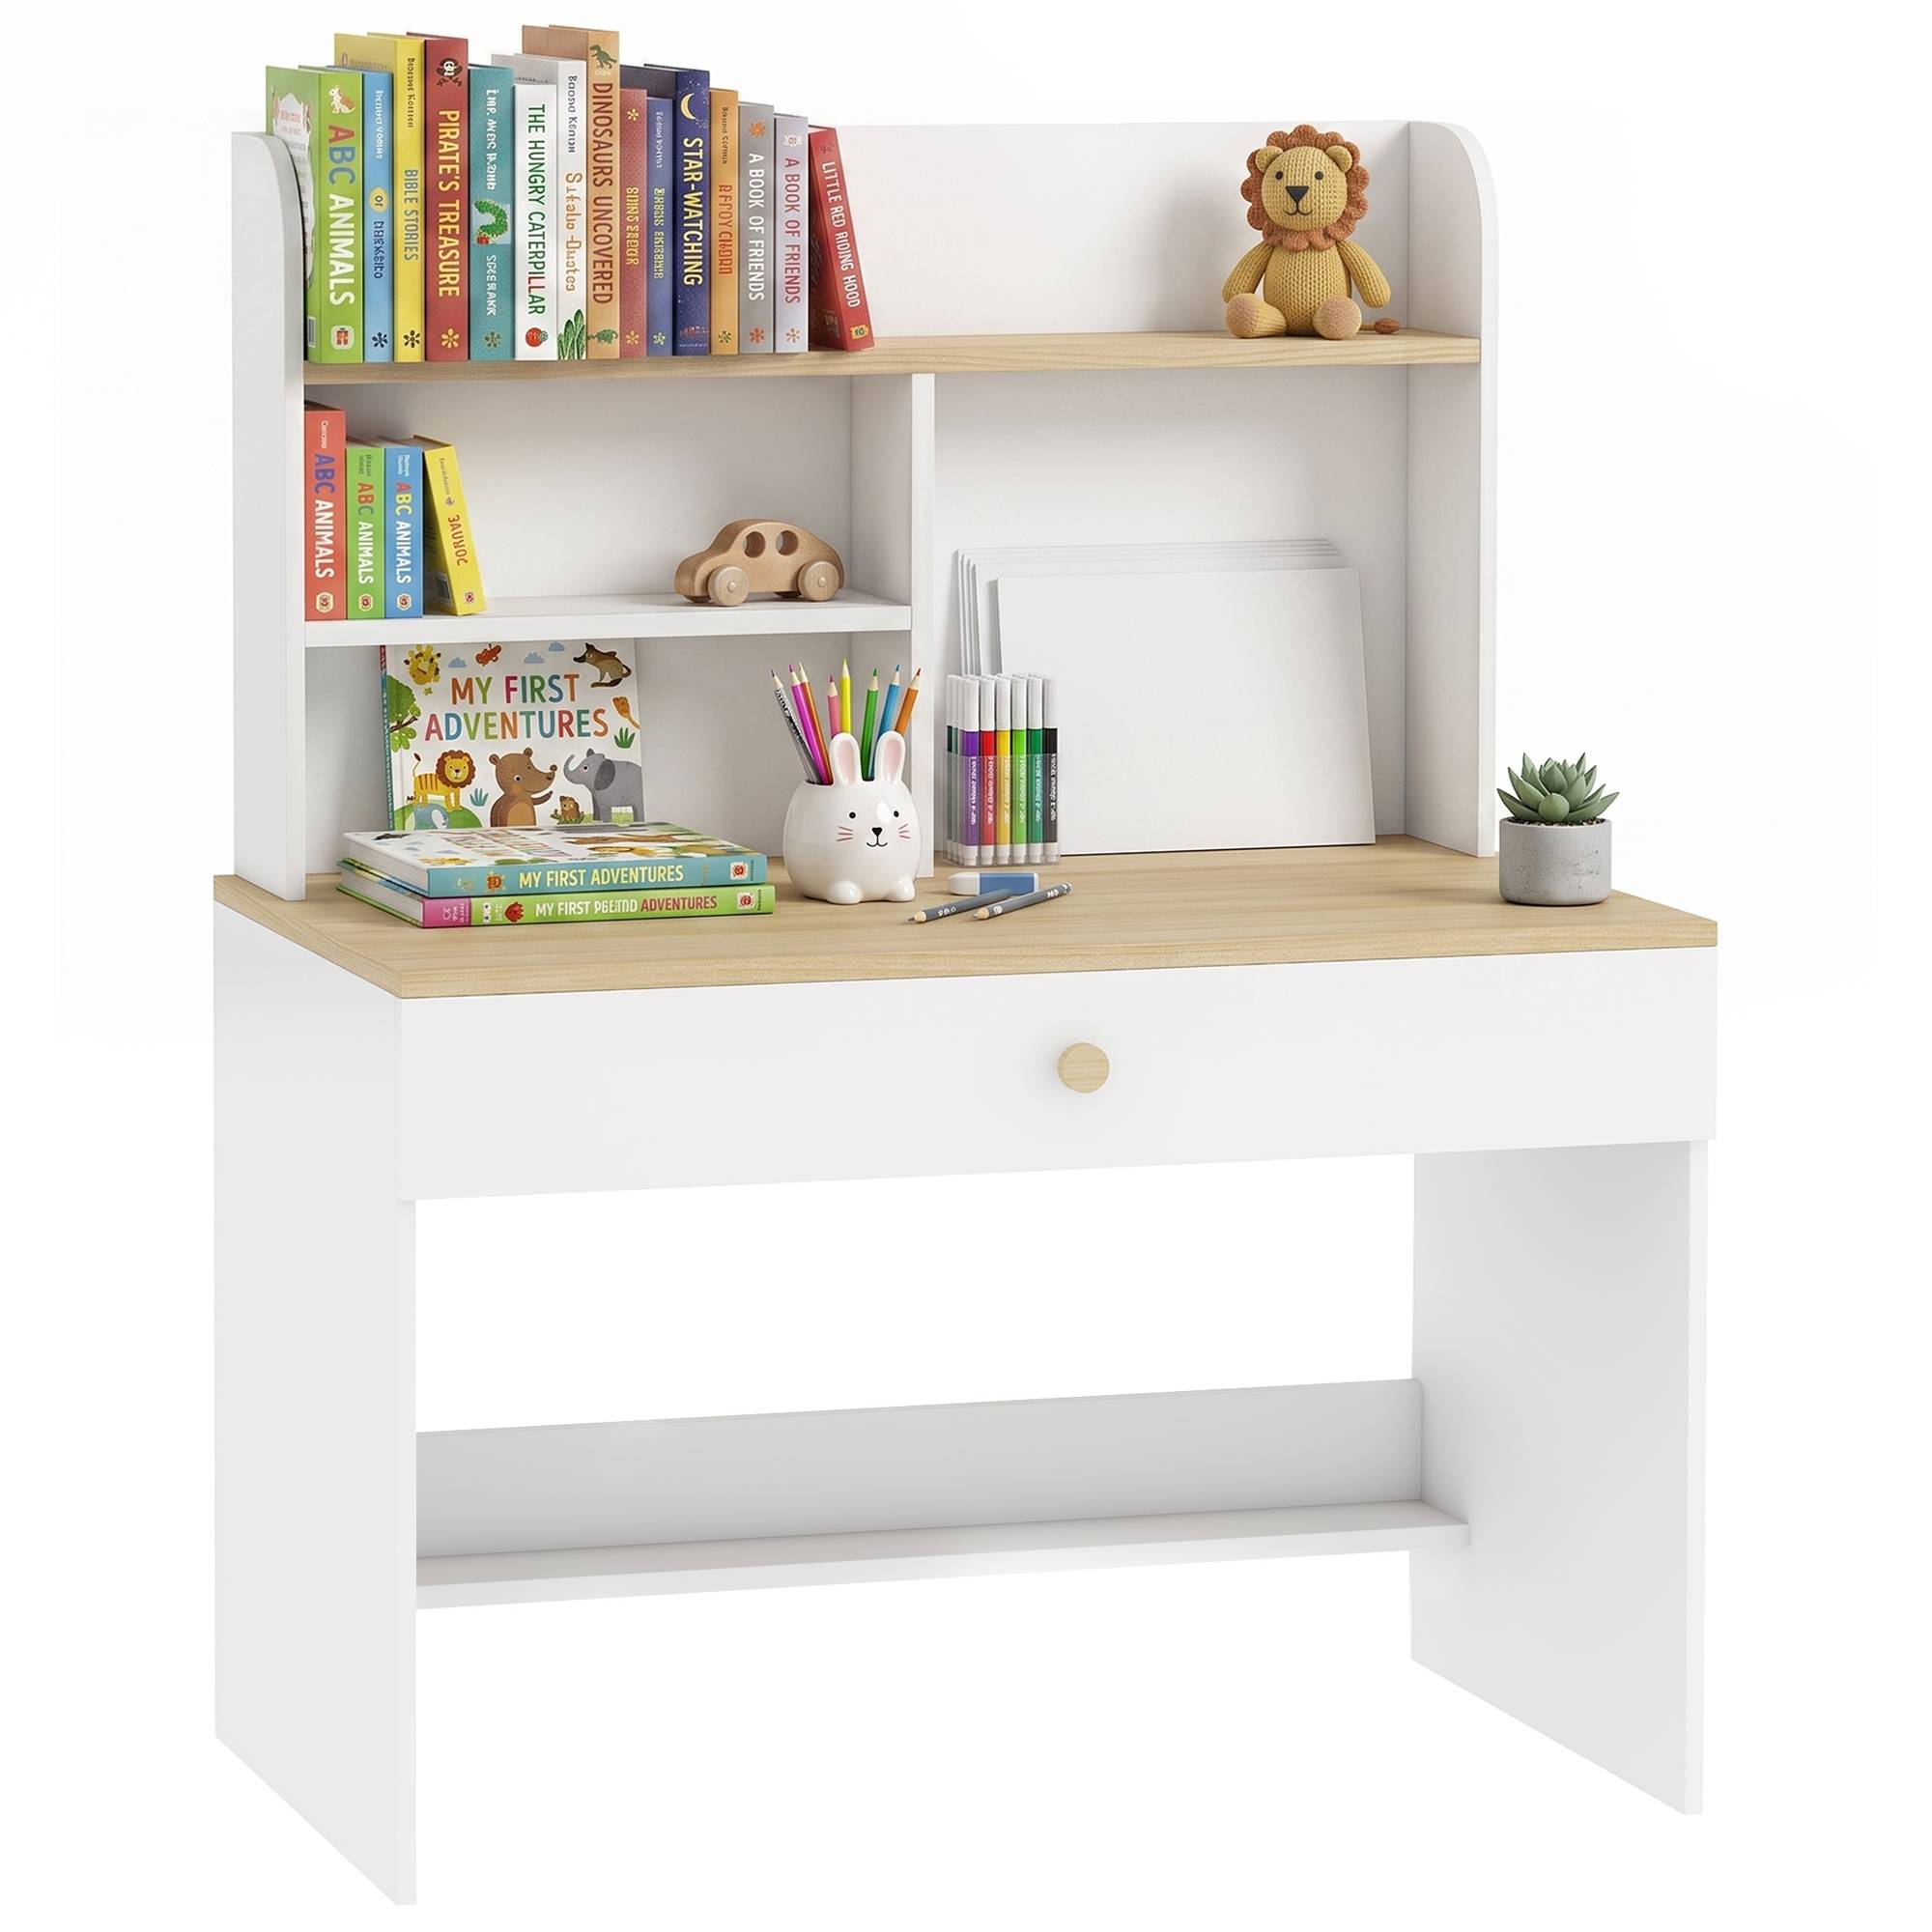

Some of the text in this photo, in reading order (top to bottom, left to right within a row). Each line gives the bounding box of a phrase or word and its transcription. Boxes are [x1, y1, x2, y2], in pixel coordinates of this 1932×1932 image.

[327, 124, 356, 306] ABC ANIMALS
[403, 168, 418, 262] BIBLE STORIES
[438, 108, 460, 298] PIRATE'S TREASURE
[527, 103, 546, 315] THE HUNGRY CATERPILLAR
[591, 82, 613, 304] DINOSAURS UNCOVERED
[682, 137, 704, 286] STAR-WATCHING
[748, 153, 765, 301] A BOOK OF FRIENDS
[783, 157, 801, 303] A BOOK OF FRIENDS
[821, 160, 862, 308] LITTLE RED RIDING HOOD
[314, 453, 335, 579] ABC ANIMALS
[357, 482, 375, 516] ABC
[357, 521, 374, 584] ANIMALS
[394, 482, 413, 516] ABC
[395, 520, 412, 584] ANIMALS
[425, 708, 609, 742] ADVENTURES
[451, 673, 580, 705] MY FIRST
[519, 865, 684, 889] MY FIRST ADVENTURES
[535, 902, 556, 917] MY
[557, 900, 591, 916] FIRST
[640, 895, 718, 912] ADVENTURES
